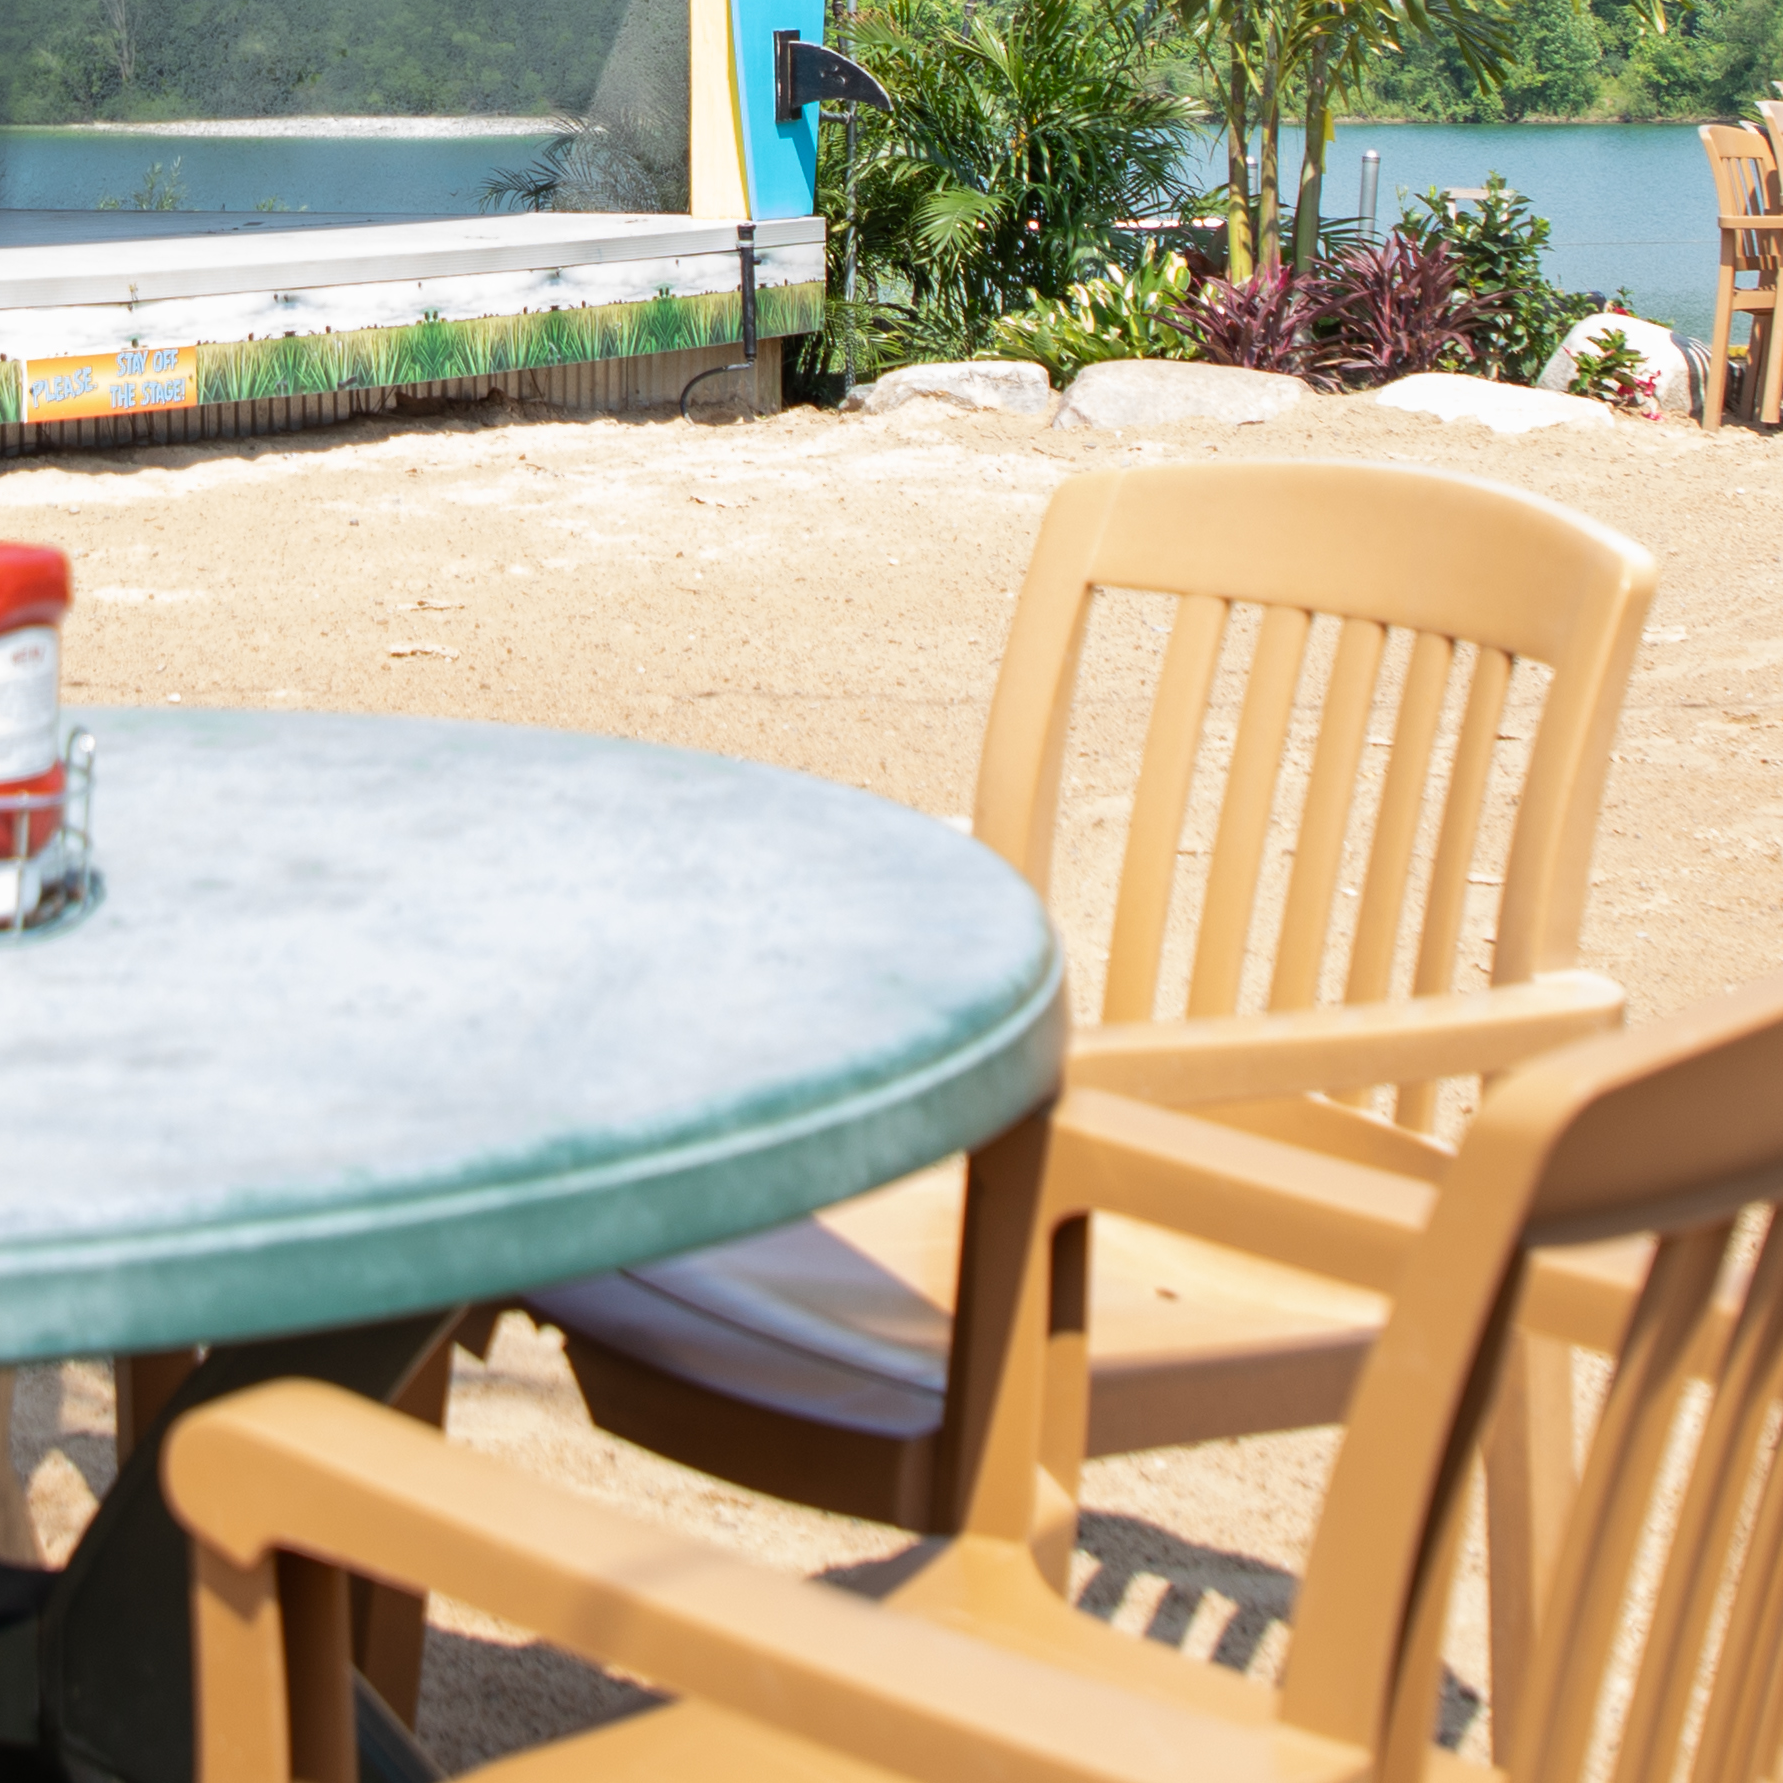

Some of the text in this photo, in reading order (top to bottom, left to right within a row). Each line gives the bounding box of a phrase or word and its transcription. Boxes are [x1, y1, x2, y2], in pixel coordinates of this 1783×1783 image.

[117, 348, 179, 377] STAY OFF
[109, 378, 187, 409] THE STAGE!
